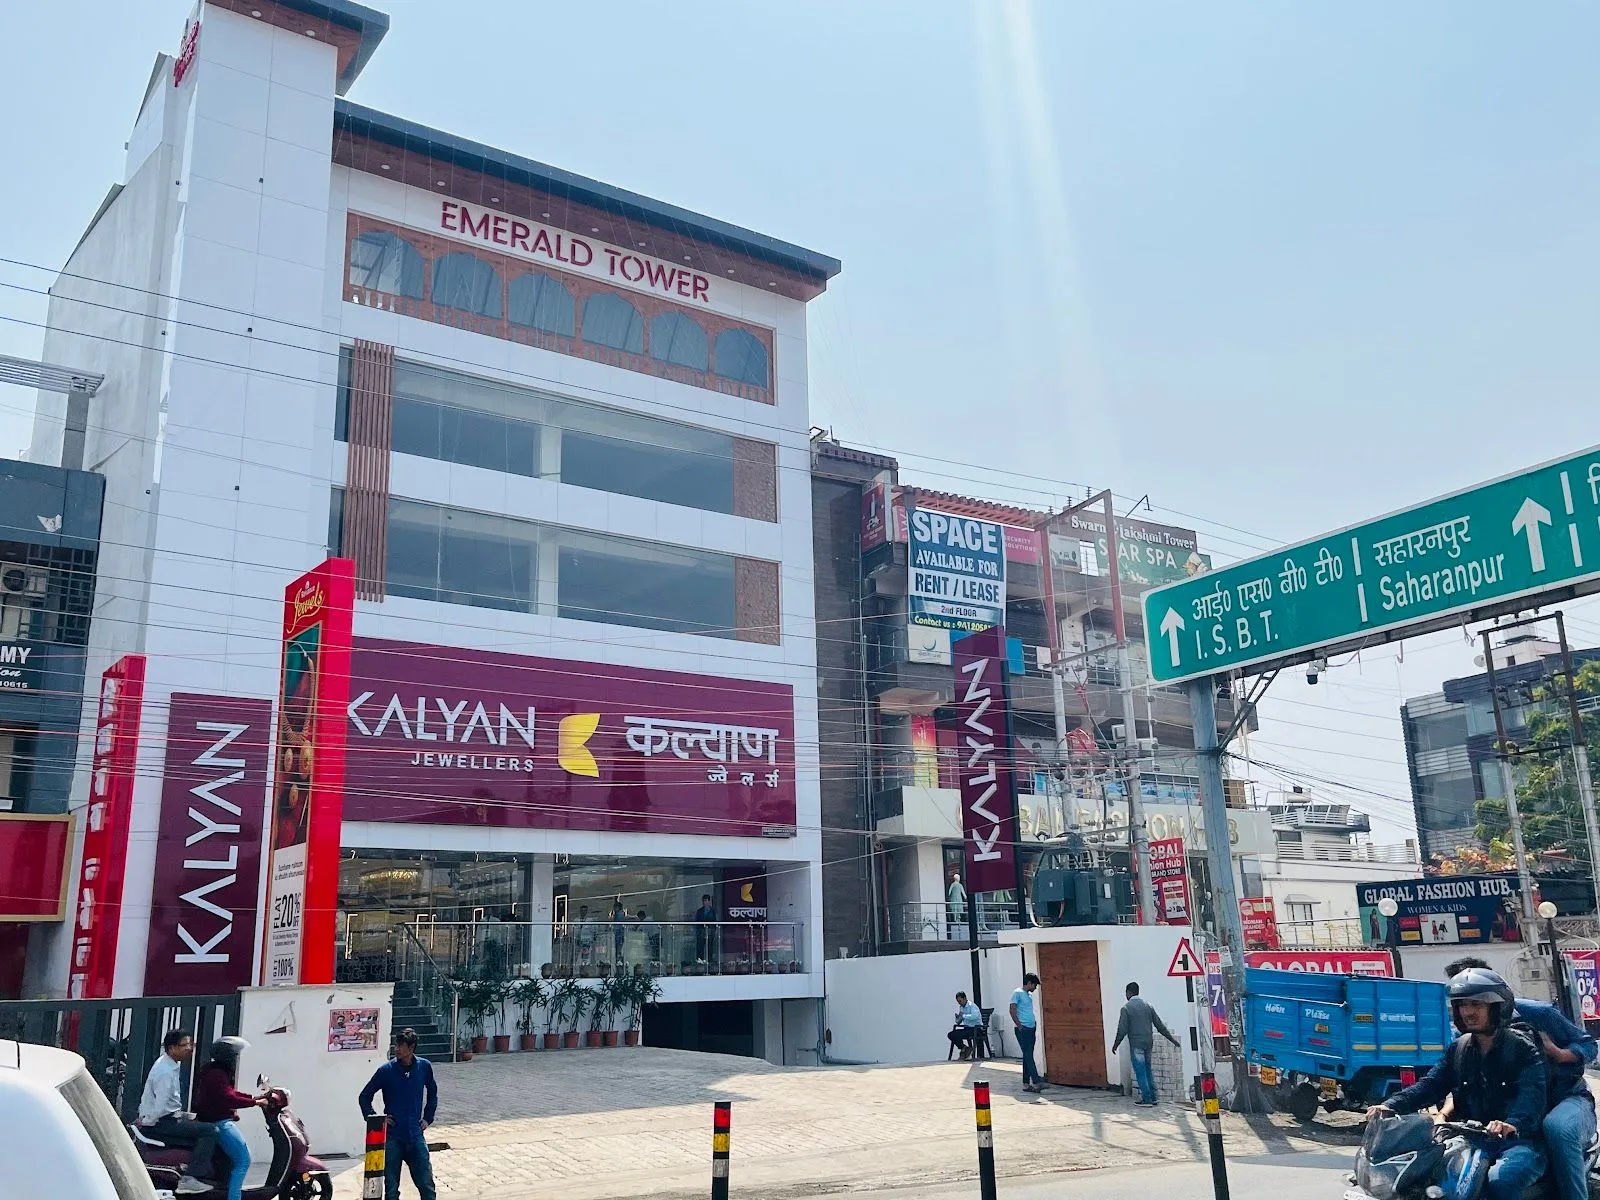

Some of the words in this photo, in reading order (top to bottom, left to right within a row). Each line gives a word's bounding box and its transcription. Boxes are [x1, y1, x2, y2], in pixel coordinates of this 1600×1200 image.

[441, 201, 593, 267] EMERALD
[604, 248, 709, 302] TOWER
[912, 511, 998, 554] SPACE
[1006, 535, 1031, 545] ECURITY
[1163, 532, 1195, 549] Tower
[1373, 515, 1471, 567] सहारनपुर
[916, 549, 975, 572] AVAILABLE
[979, 560, 998, 576] FOR
[1098, 538, 1141, 563] SAR
[1146, 547, 1177, 569] SPA
[915, 572, 949, 595] RENT
[963, 580, 1000, 603] LEASE
[1380, 553, 1504, 611] Saharanpur
[914, 615, 941, 627] Contact
[943, 620, 950, 628] us
[941, 605, 954, 615] 2nd
[956, 608, 977, 617] FLOOR
[346, 691, 535, 750] KALYAN
[624, 716, 779, 766] कल्याण
[411, 752, 534, 773] JEWELLERS
[962, 658, 1002, 862] KALYAN
[174, 721, 250, 963] KALYAN
[1166, 858, 1182, 869] Hub
[1364, 885, 1413, 905] GLOBAL
[1417, 881, 1475, 900] FASHION
[1479, 878, 1510, 897] HUB
[728, 907, 767, 918] कल्याण
[1407, 904, 1440, 914] WOMEN
[1447, 903, 1467, 913] KIDS
[1577, 977, 1598, 995] 0%
